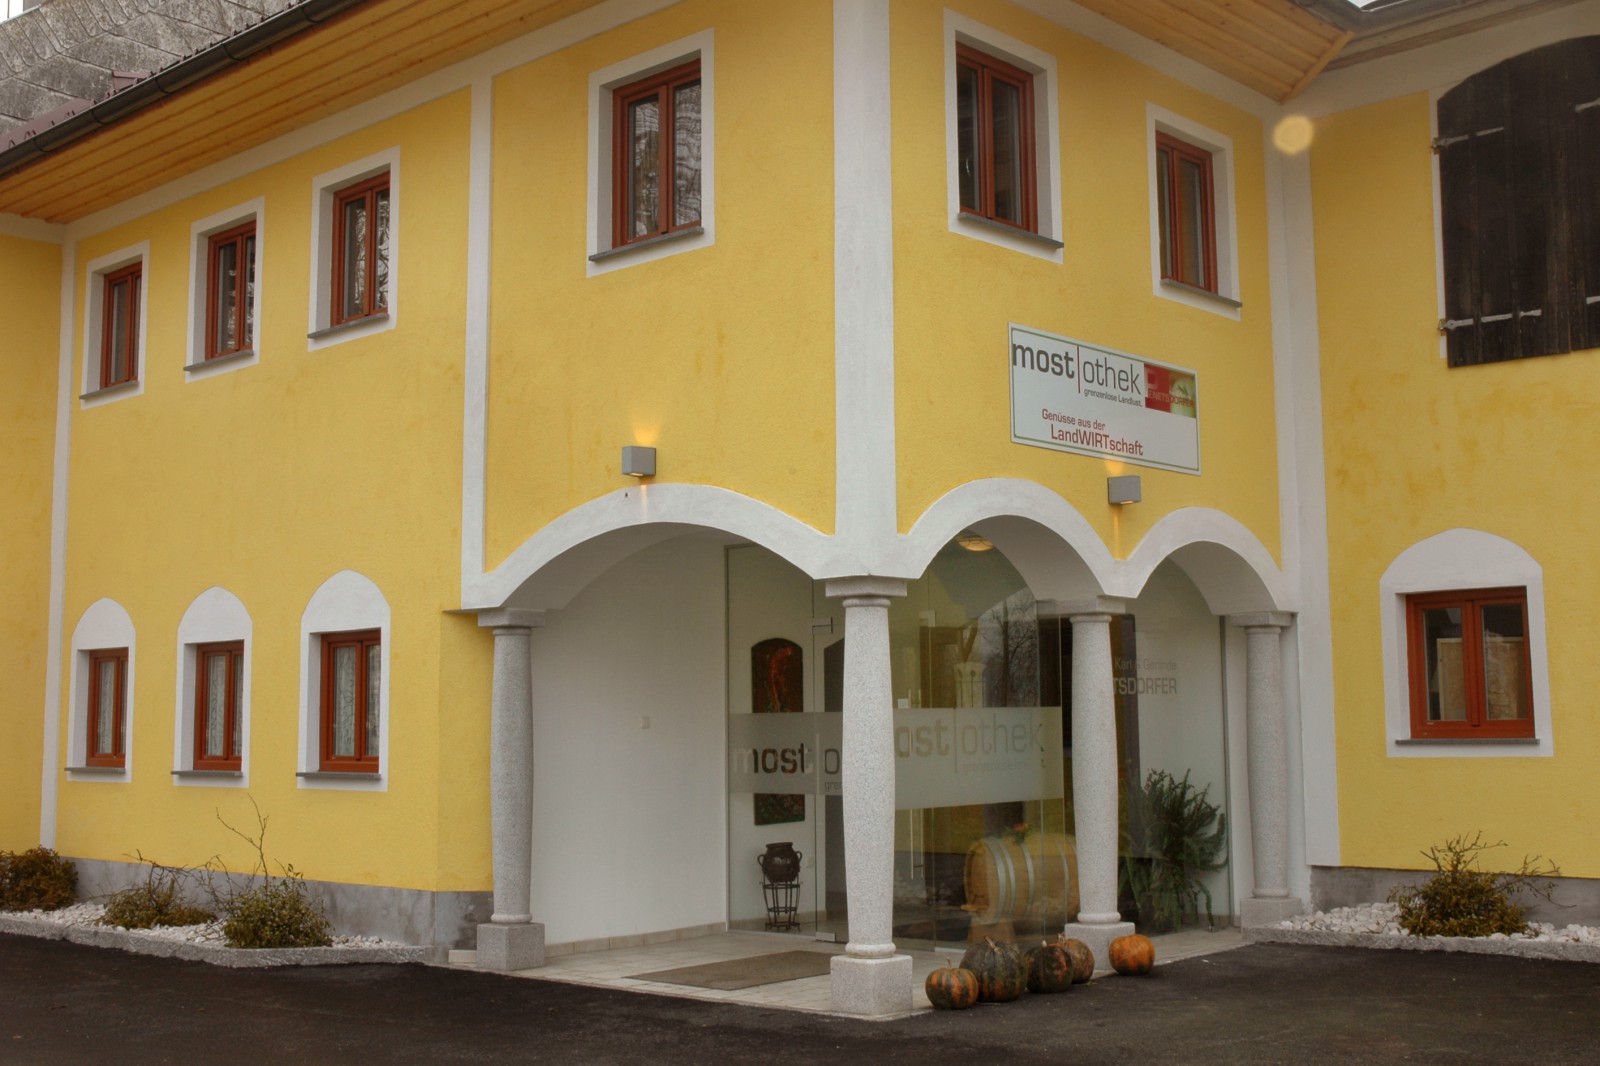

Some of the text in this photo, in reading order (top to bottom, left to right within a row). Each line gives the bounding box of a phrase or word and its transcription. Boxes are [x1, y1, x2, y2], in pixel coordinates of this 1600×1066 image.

[1083, 388, 1118, 402] grenzenlose
[1041, 408, 1106, 431] Genüsse aus der
[1050, 423, 1144, 456] LandWIRTschaft
[1113, 676, 1178, 695] TSDORFER
[893, 719, 950, 758] ost
[733, 742, 814, 775] most
